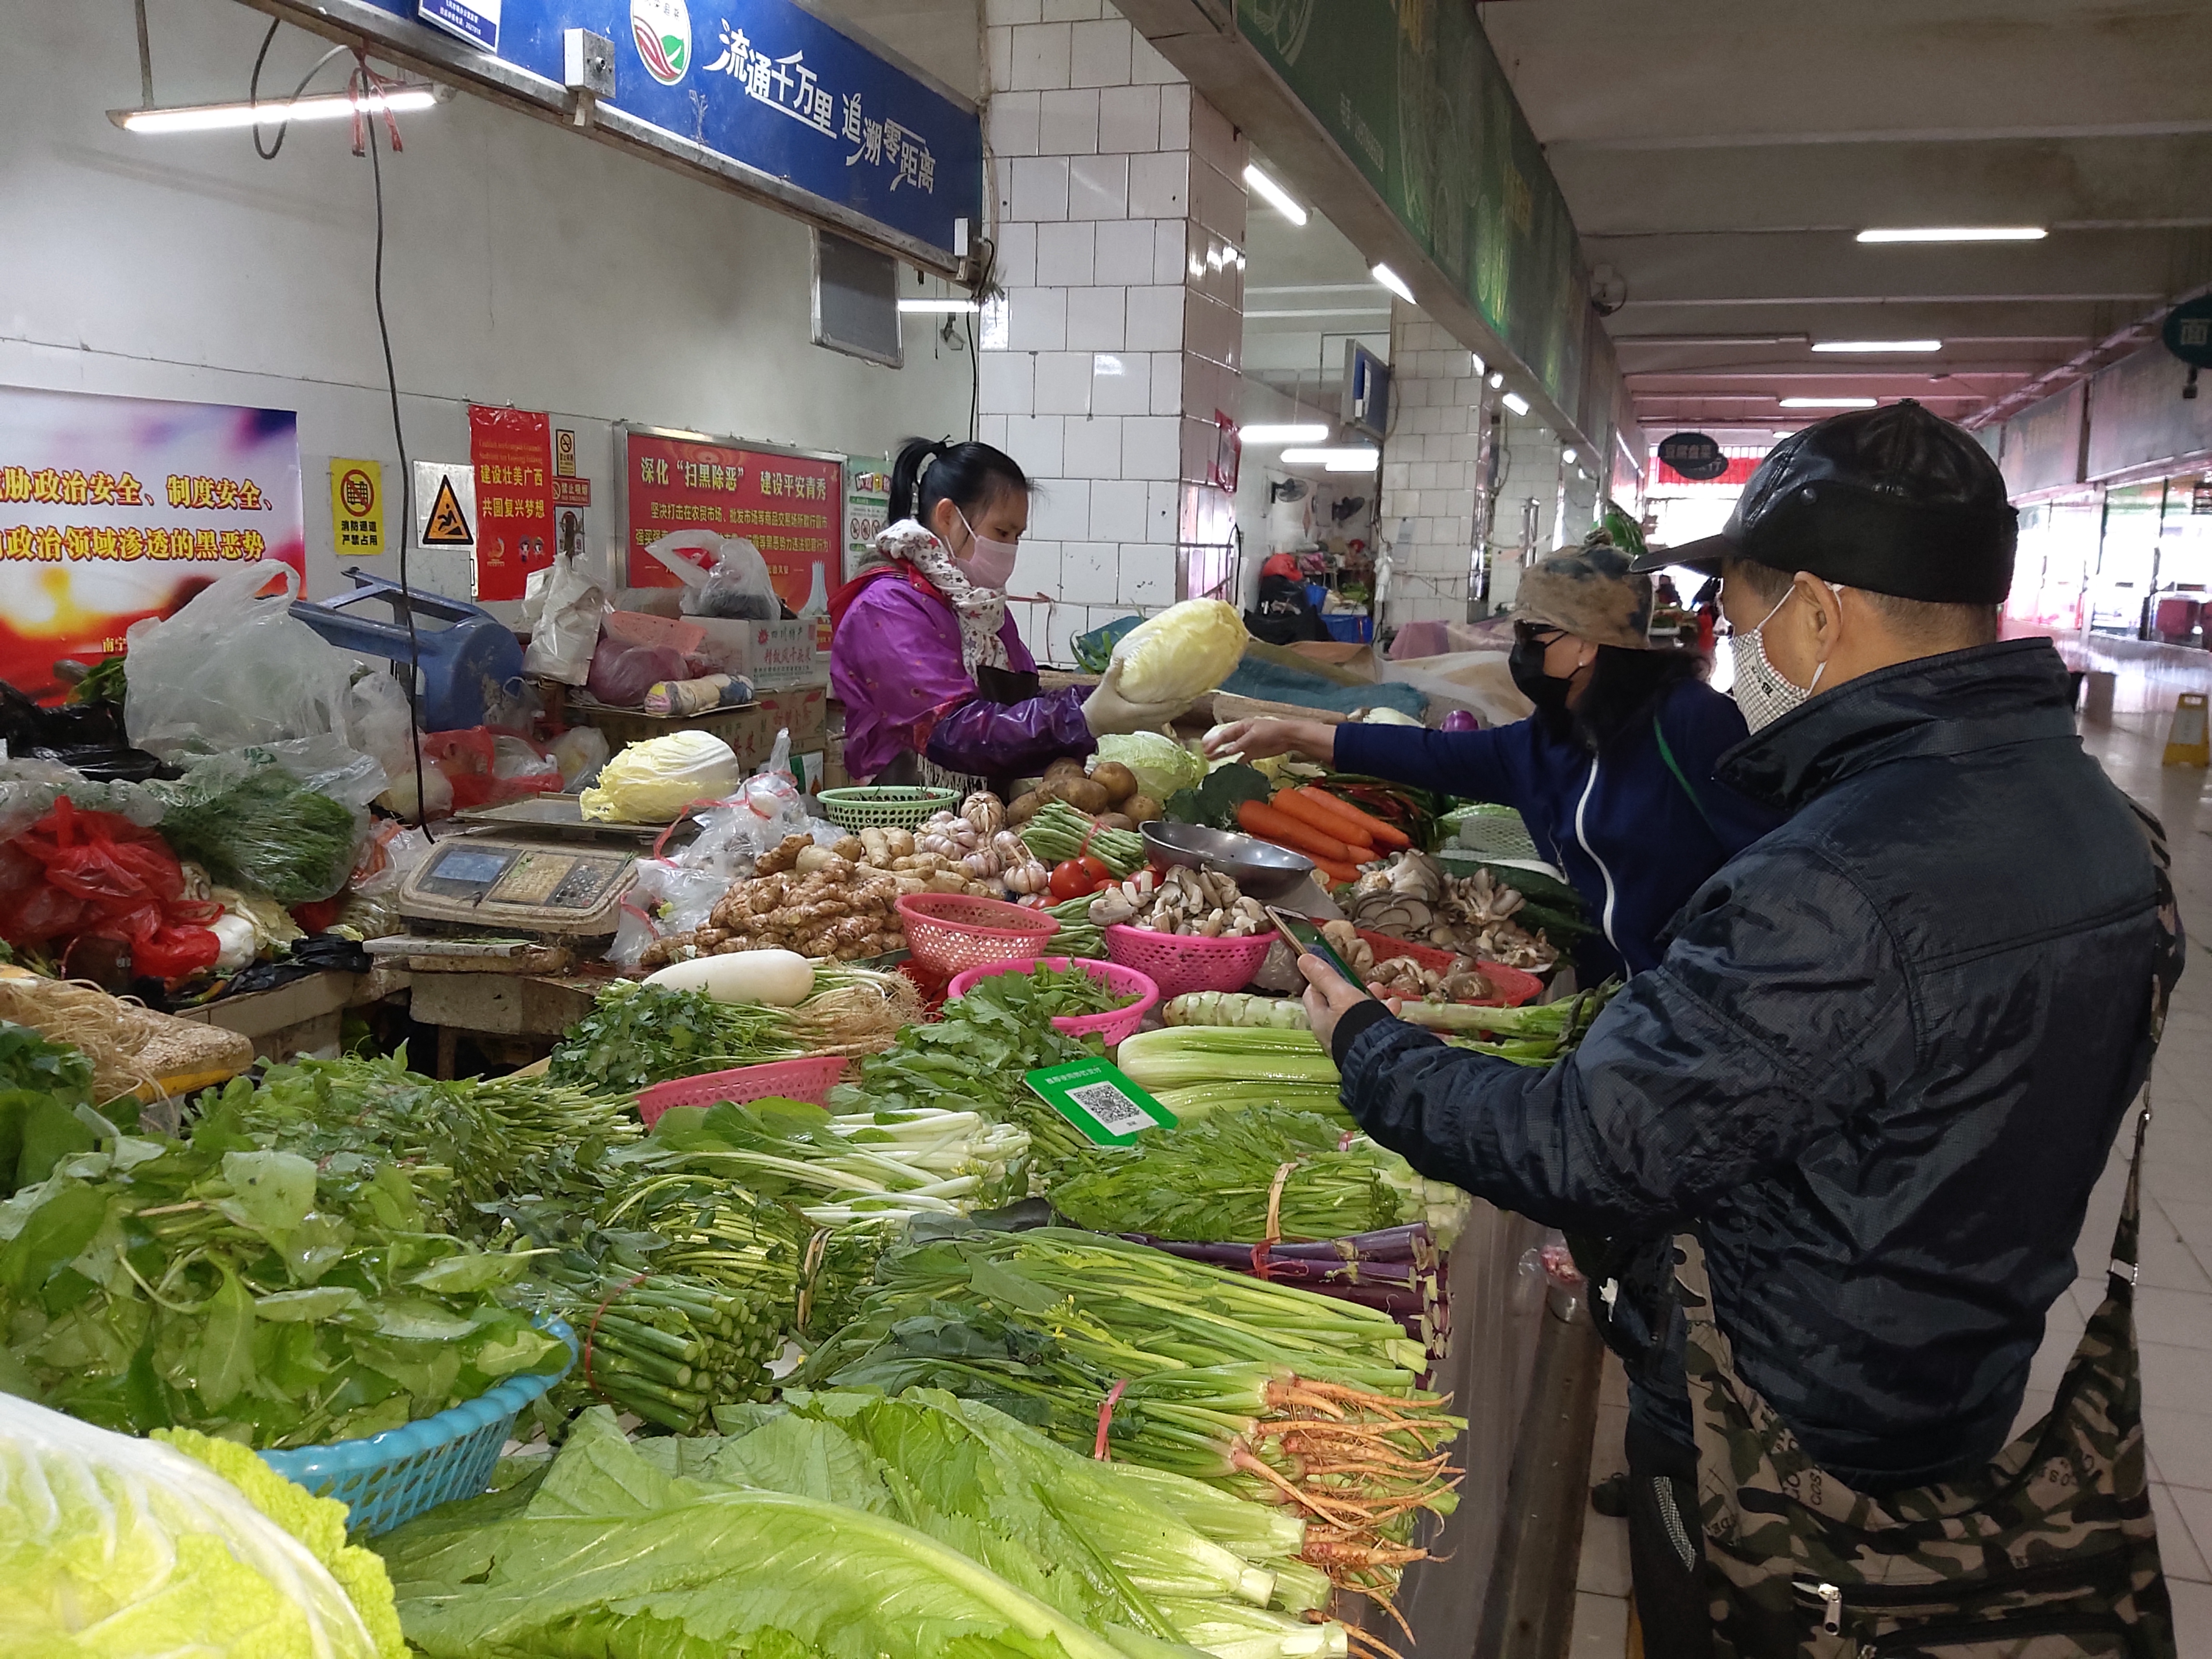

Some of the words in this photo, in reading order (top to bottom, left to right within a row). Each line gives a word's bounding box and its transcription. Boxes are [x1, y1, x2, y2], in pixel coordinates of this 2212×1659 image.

[703, 18, 837, 139] 流通千万里
[842, 93, 936, 194] 追溯零距离
[0, 466, 273, 510] 胁政治安全、制度安全、
[480, 464, 543, 487] 建设壮美广西
[760, 470, 826, 501] 建设平安青秀
[482, 497, 545, 519] 共圆复兴梦想
[341, 520, 376, 532] 消防通道
[0, 524, 266, 562] 政治领域渗透的黑恶势
[342, 534, 378, 546] 严禁占用
